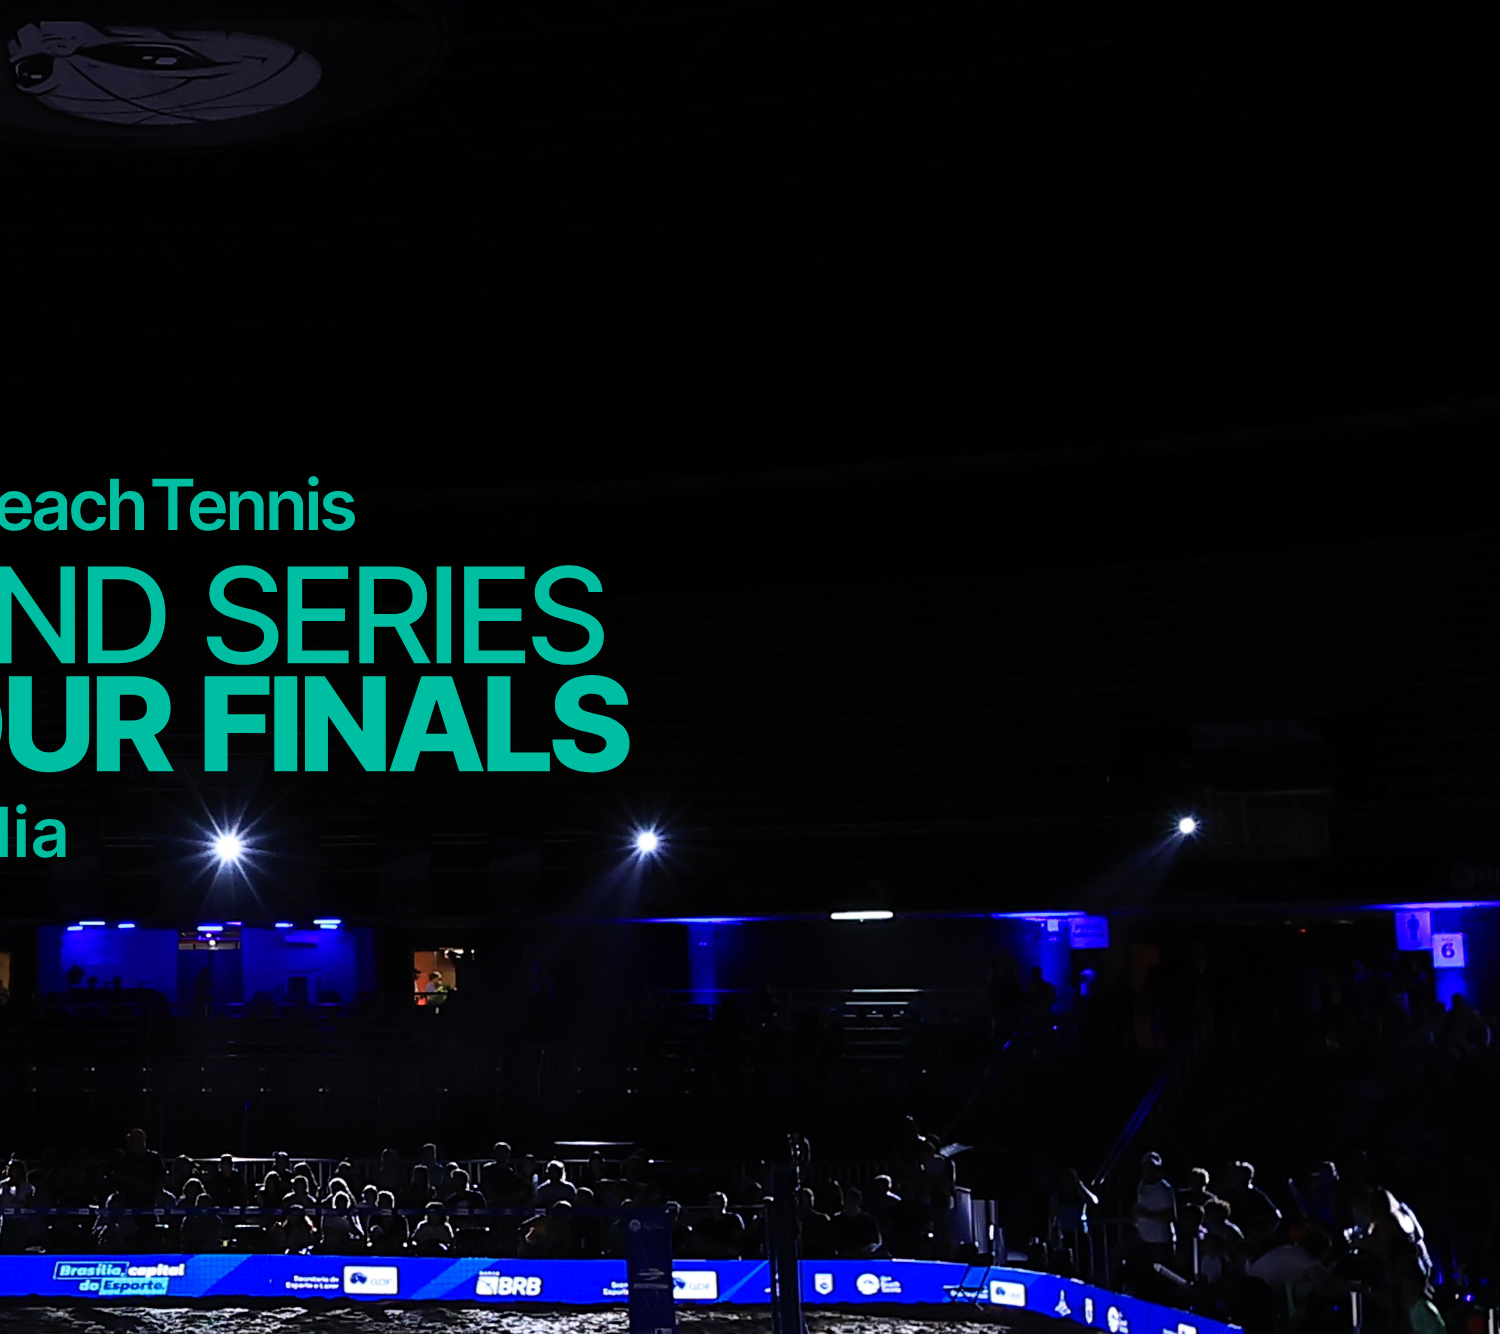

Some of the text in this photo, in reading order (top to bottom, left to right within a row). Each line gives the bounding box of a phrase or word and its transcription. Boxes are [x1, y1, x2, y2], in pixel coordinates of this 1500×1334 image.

[1441, 942, 1455, 958] 6
[59, 1263, 186, 1278] Brasília, capital
[78, 1278, 99, 1292] do
[497, 1276, 542, 1296] BRB
